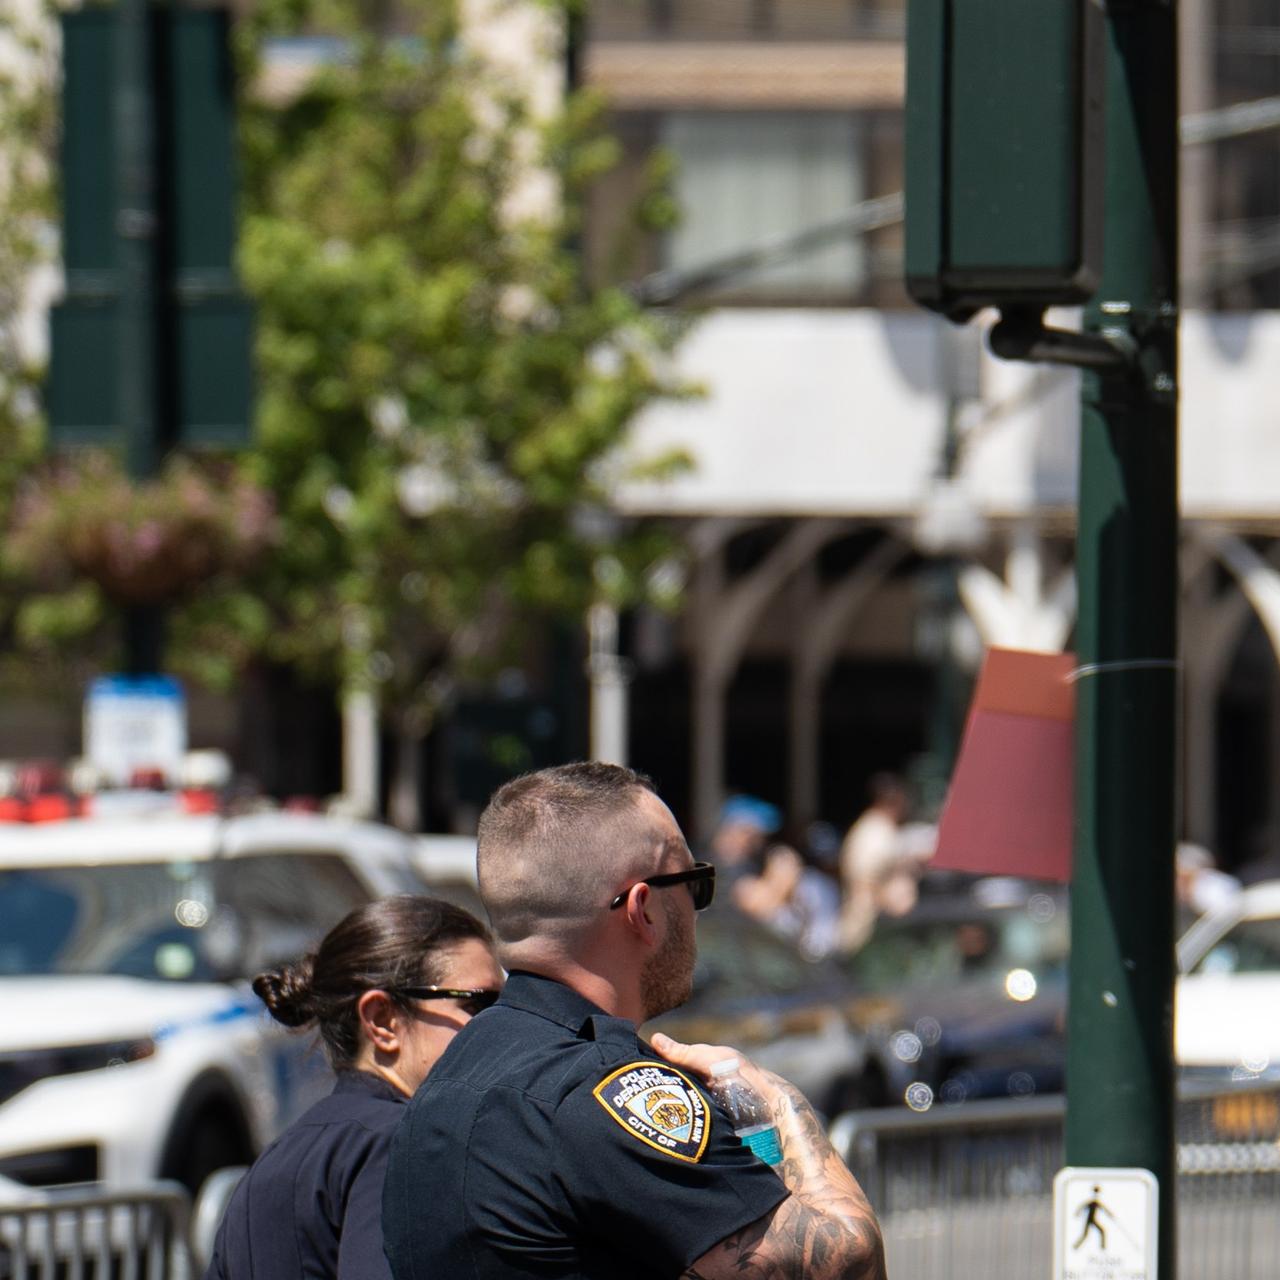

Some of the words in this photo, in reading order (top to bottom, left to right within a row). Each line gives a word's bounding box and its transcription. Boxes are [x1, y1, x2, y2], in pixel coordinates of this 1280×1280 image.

[613, 1075, 685, 1109] DEPARTMENT
[619, 1067, 663, 1088] POLICE
[627, 1116, 657, 1138] CITY
[657, 1135, 678, 1149] OF
